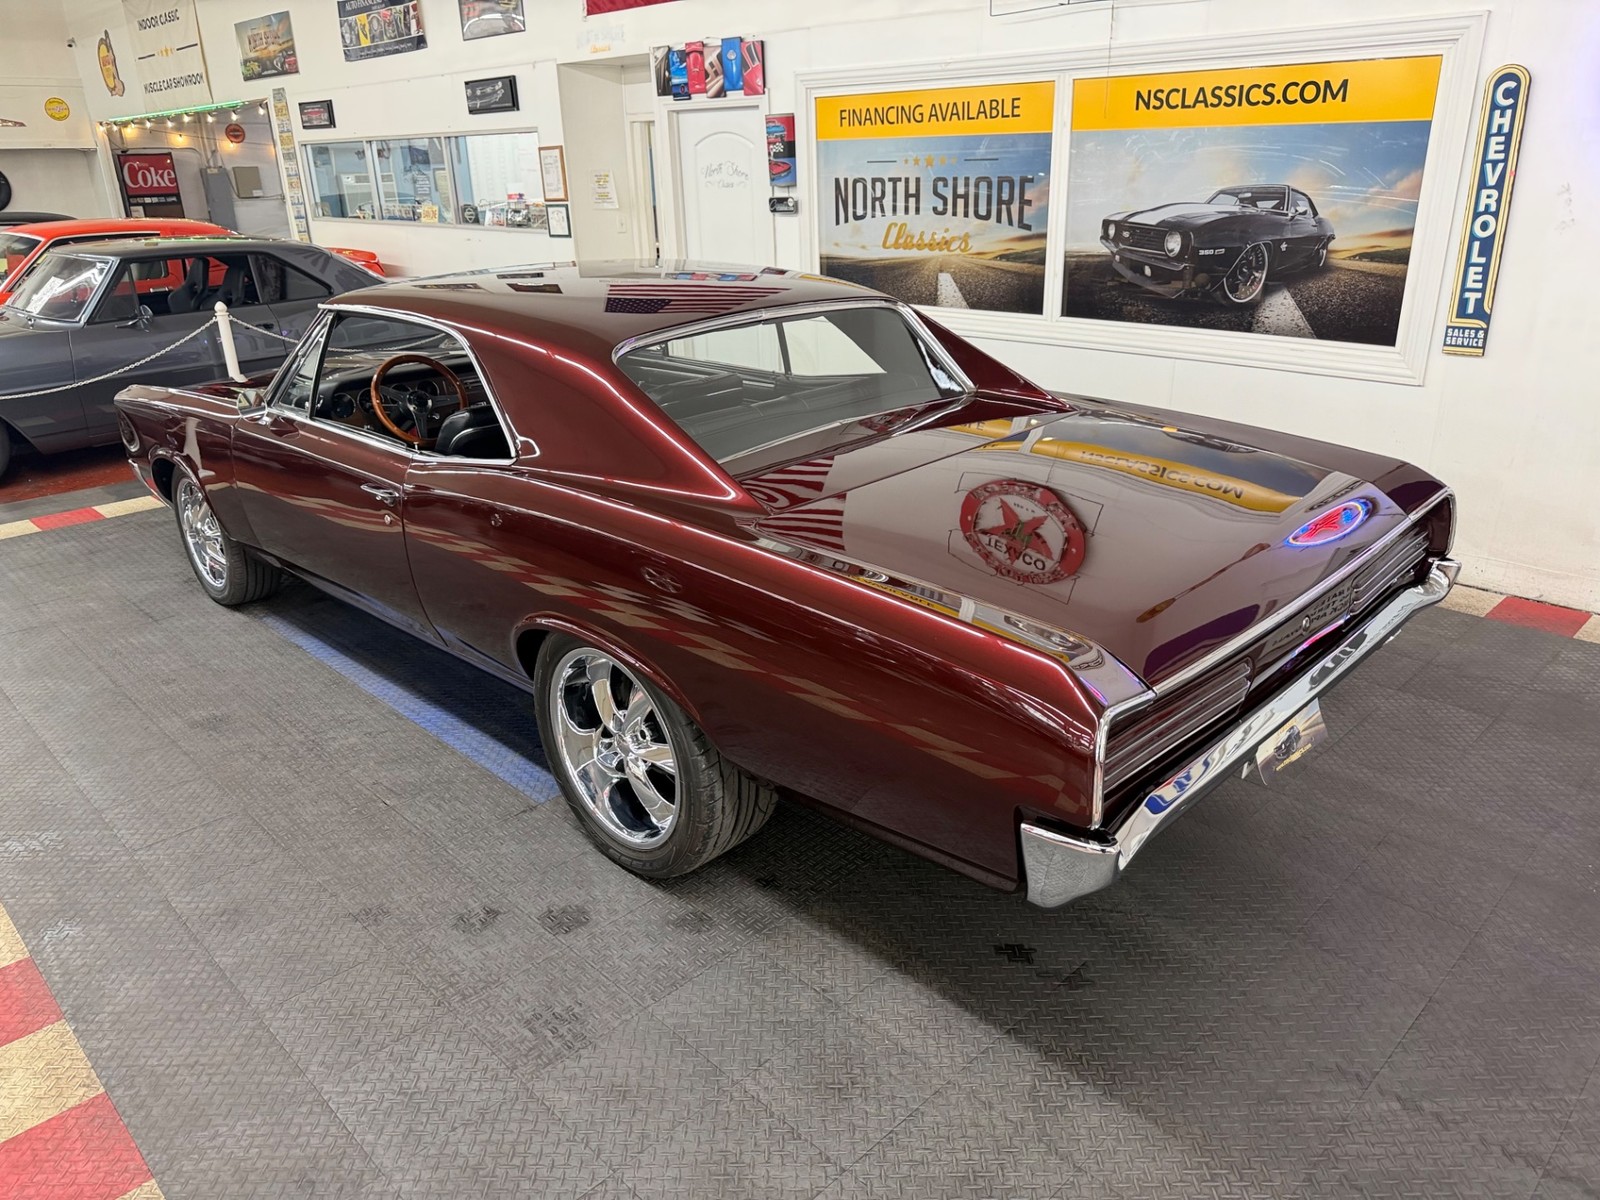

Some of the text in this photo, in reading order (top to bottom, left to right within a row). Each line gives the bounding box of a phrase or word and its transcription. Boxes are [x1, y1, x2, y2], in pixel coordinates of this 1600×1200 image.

[137, 8, 180, 31] INDOOR CLASSIC
[143, 71, 205, 94] MUSCLE CAR SHOWROOM
[1135, 78, 1349, 111] NSCLASSICS.COM
[839, 97, 1021, 128] FINANCING AVAILABLE
[123, 161, 177, 188] Coke
[834, 175, 1035, 231] NORTH SHORE
[1463, 81, 1518, 315] CHEVROLET
[881, 221, 973, 253] Classics
[1445, 336, 1484, 347] SERVICE
[1447, 328, 1485, 338] SALES &
